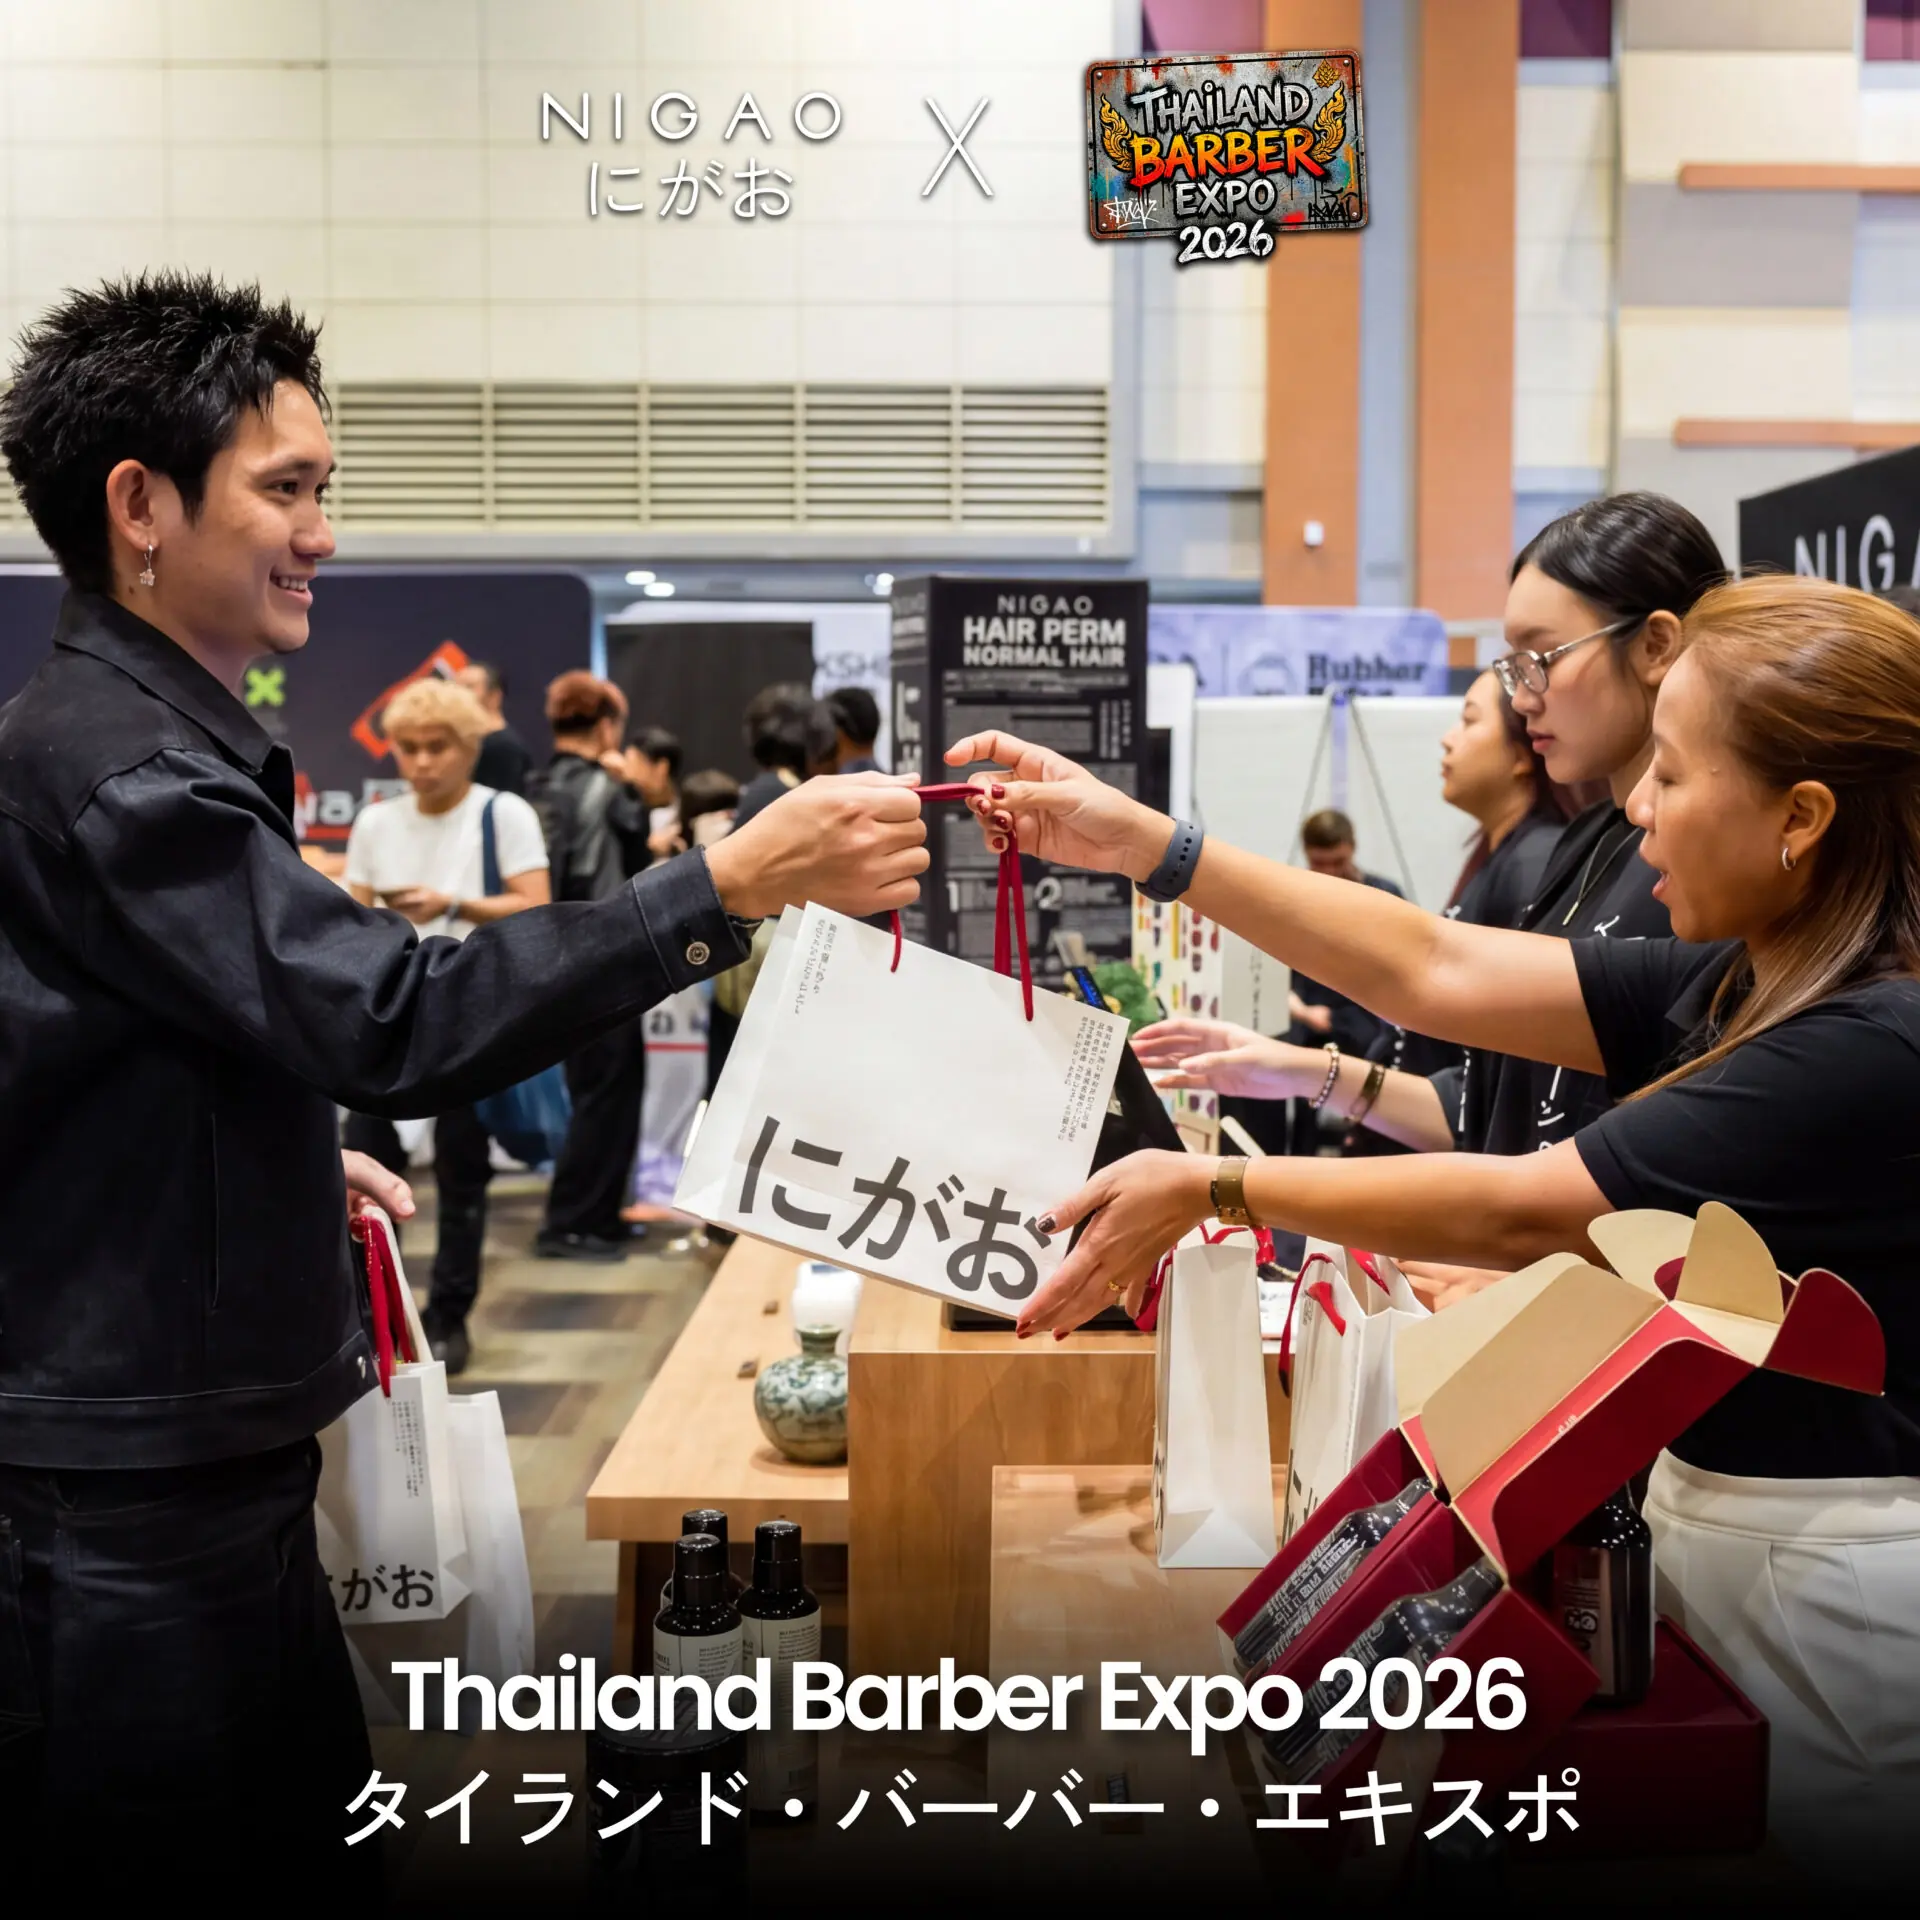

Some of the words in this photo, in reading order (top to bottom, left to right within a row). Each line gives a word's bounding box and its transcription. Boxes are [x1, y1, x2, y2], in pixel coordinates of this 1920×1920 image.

[1795, 513, 1920, 593] NIG
[998, 595, 1093, 615] NIGAO
[964, 618, 1035, 645] HAIR
[1043, 618, 1126, 646] PERM
[963, 646, 1064, 667] NORMAL
[1070, 647, 1125, 667] HAIR
[738, 1115, 1052, 1301] にがお
[327, 1564, 434, 1611] がお
